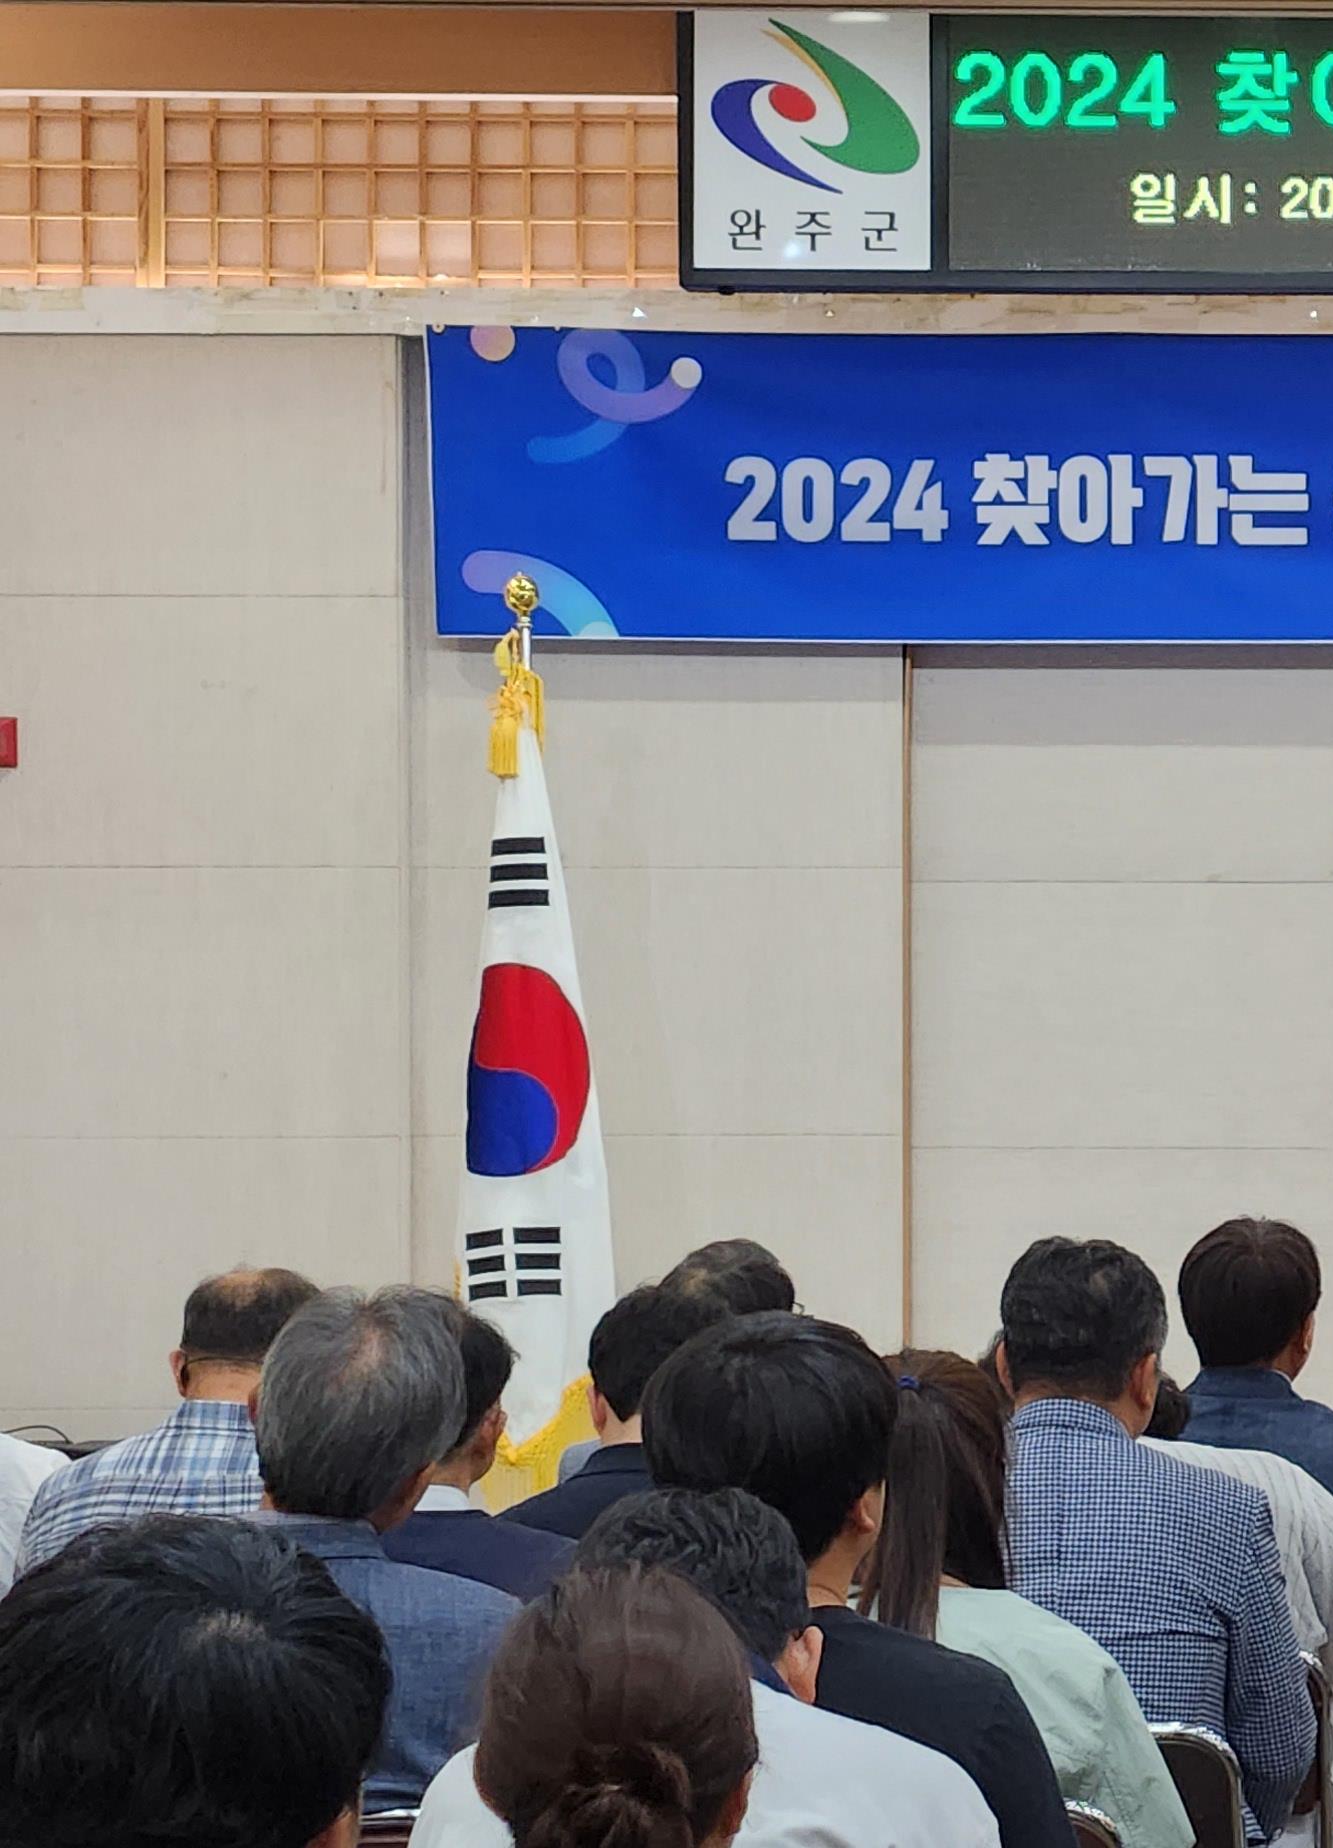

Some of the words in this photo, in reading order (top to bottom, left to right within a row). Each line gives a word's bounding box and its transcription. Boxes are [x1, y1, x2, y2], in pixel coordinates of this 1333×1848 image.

[953, 51, 1177, 130] 2024
[1129, 173, 1258, 225] 일시:
[724, 457, 949, 543] 2024
[972, 452, 1311, 547] 찾아가는
